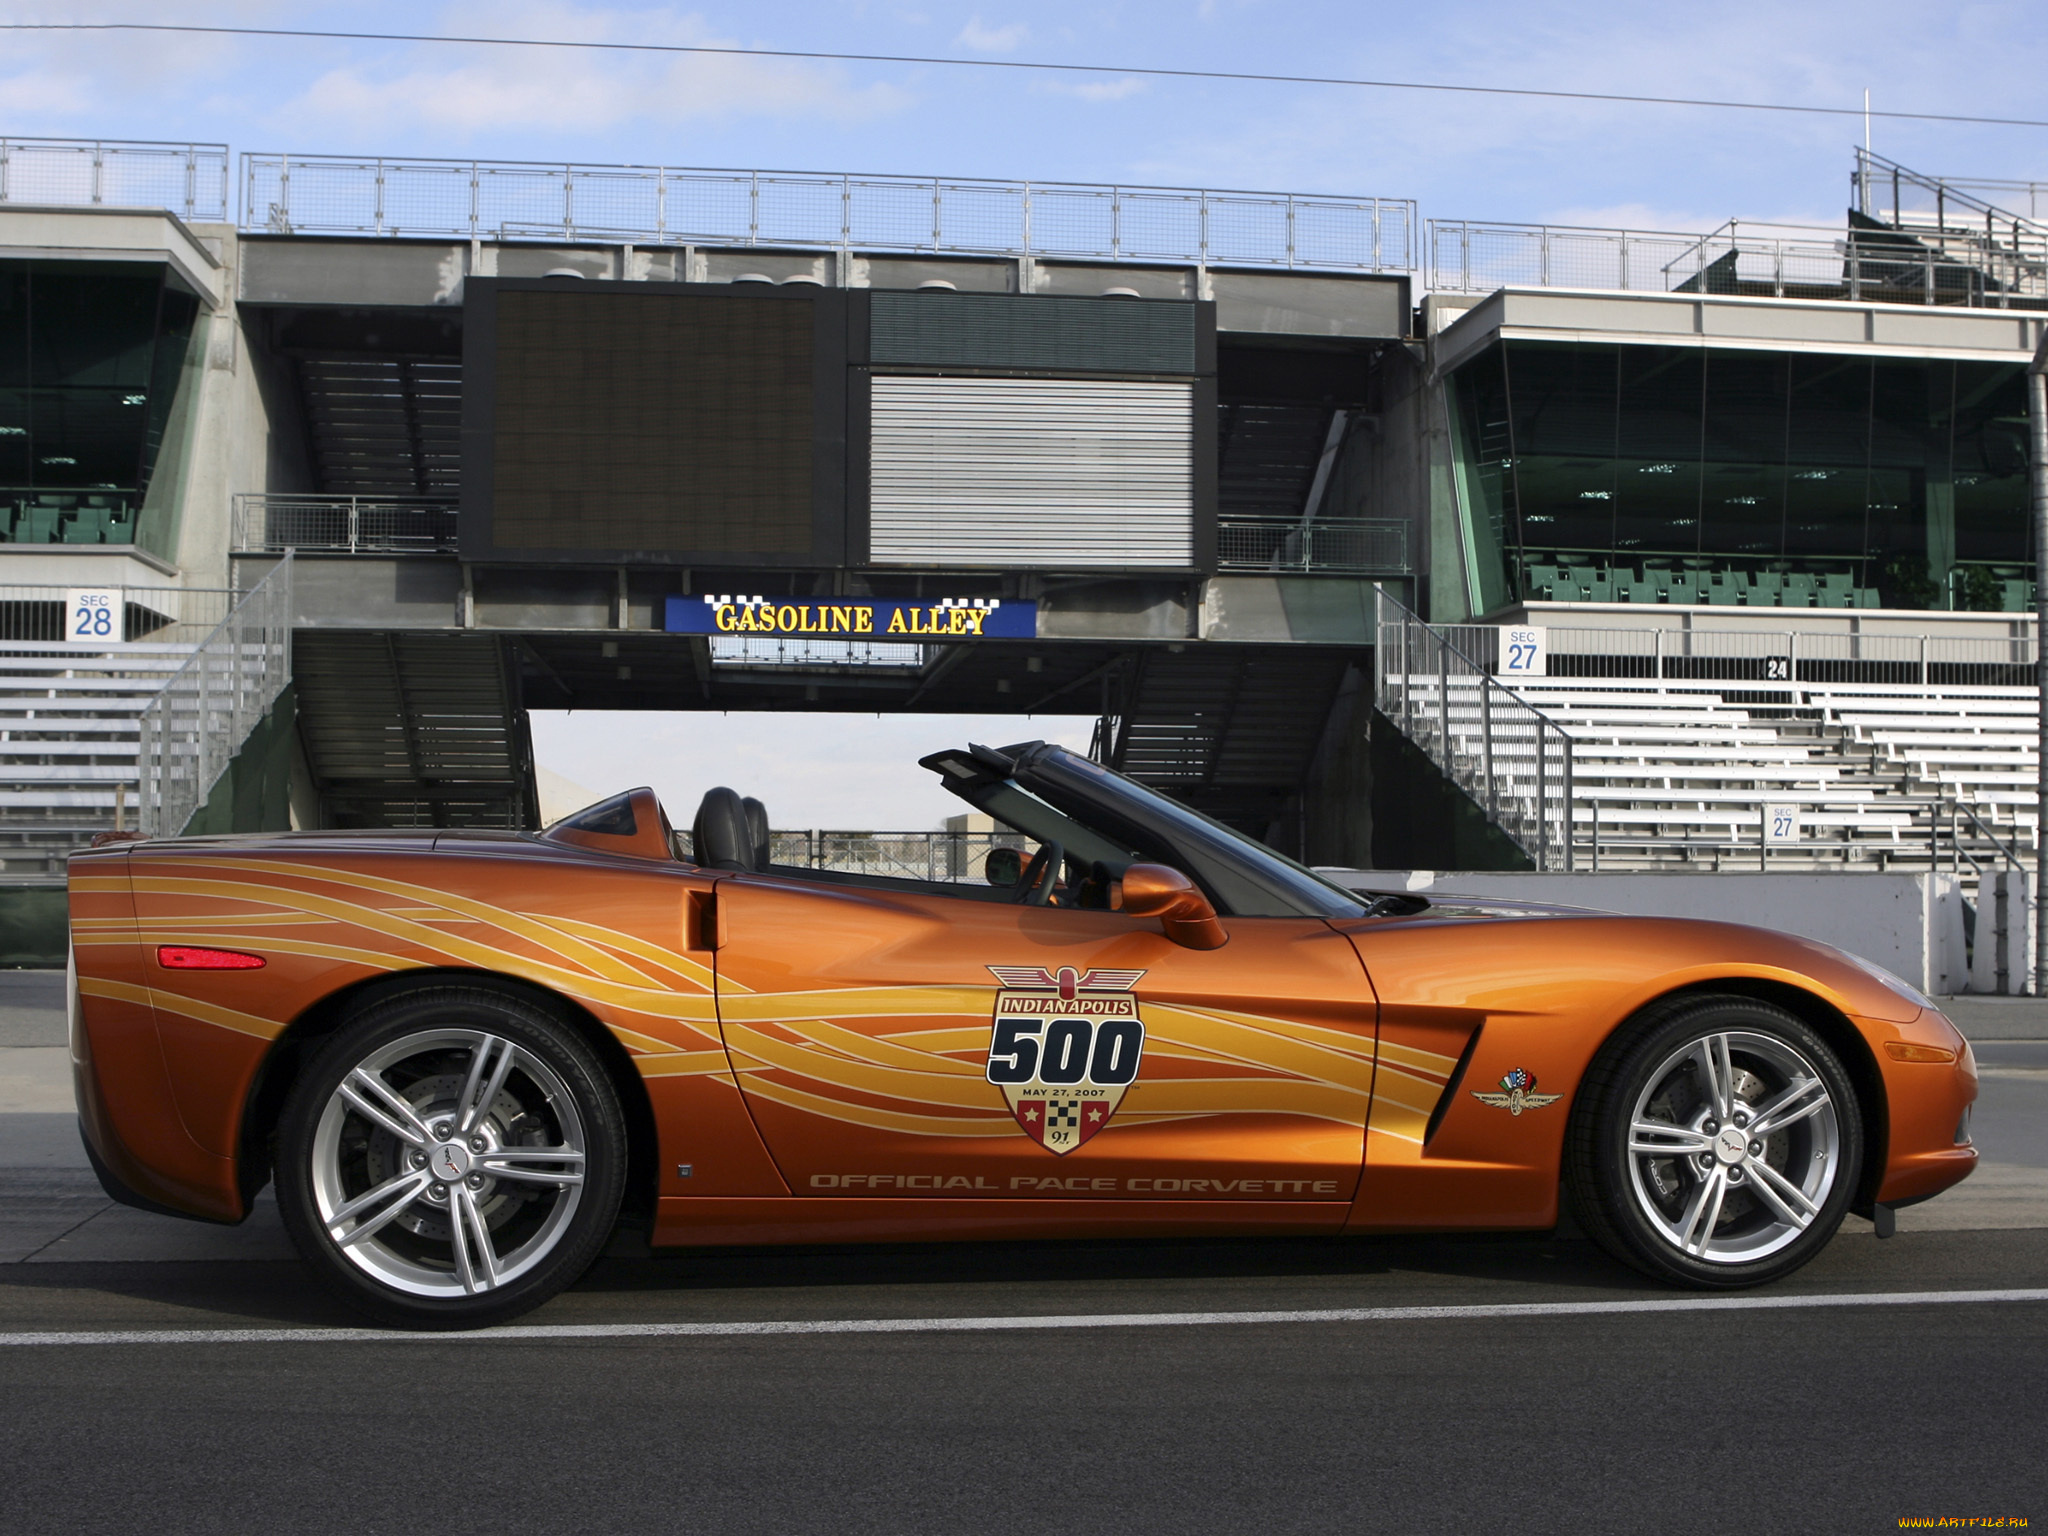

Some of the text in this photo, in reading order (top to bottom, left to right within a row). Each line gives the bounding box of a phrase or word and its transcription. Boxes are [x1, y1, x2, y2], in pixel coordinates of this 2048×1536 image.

[80, 595, 109, 606] SEC
[75, 608, 111, 635] 28
[716, 604, 988, 635] GASOLINE ALLEY
[1511, 631, 1535, 642] SEC
[1508, 644, 1537, 669] 27
[1767, 660, 1787, 678] 24
[1774, 808, 1792, 816] SEC
[1774, 817, 1792, 836] 27
[1003, 998, 1130, 1015] INDIANAPOLIS
[986, 1017, 1145, 1086] 500
[1052, 1089, 1070, 1097] 27,
[1074, 1089, 1106, 1097] 2007
[809, 1174, 1338, 1193] OFFICIAL PACE CORVETTE
